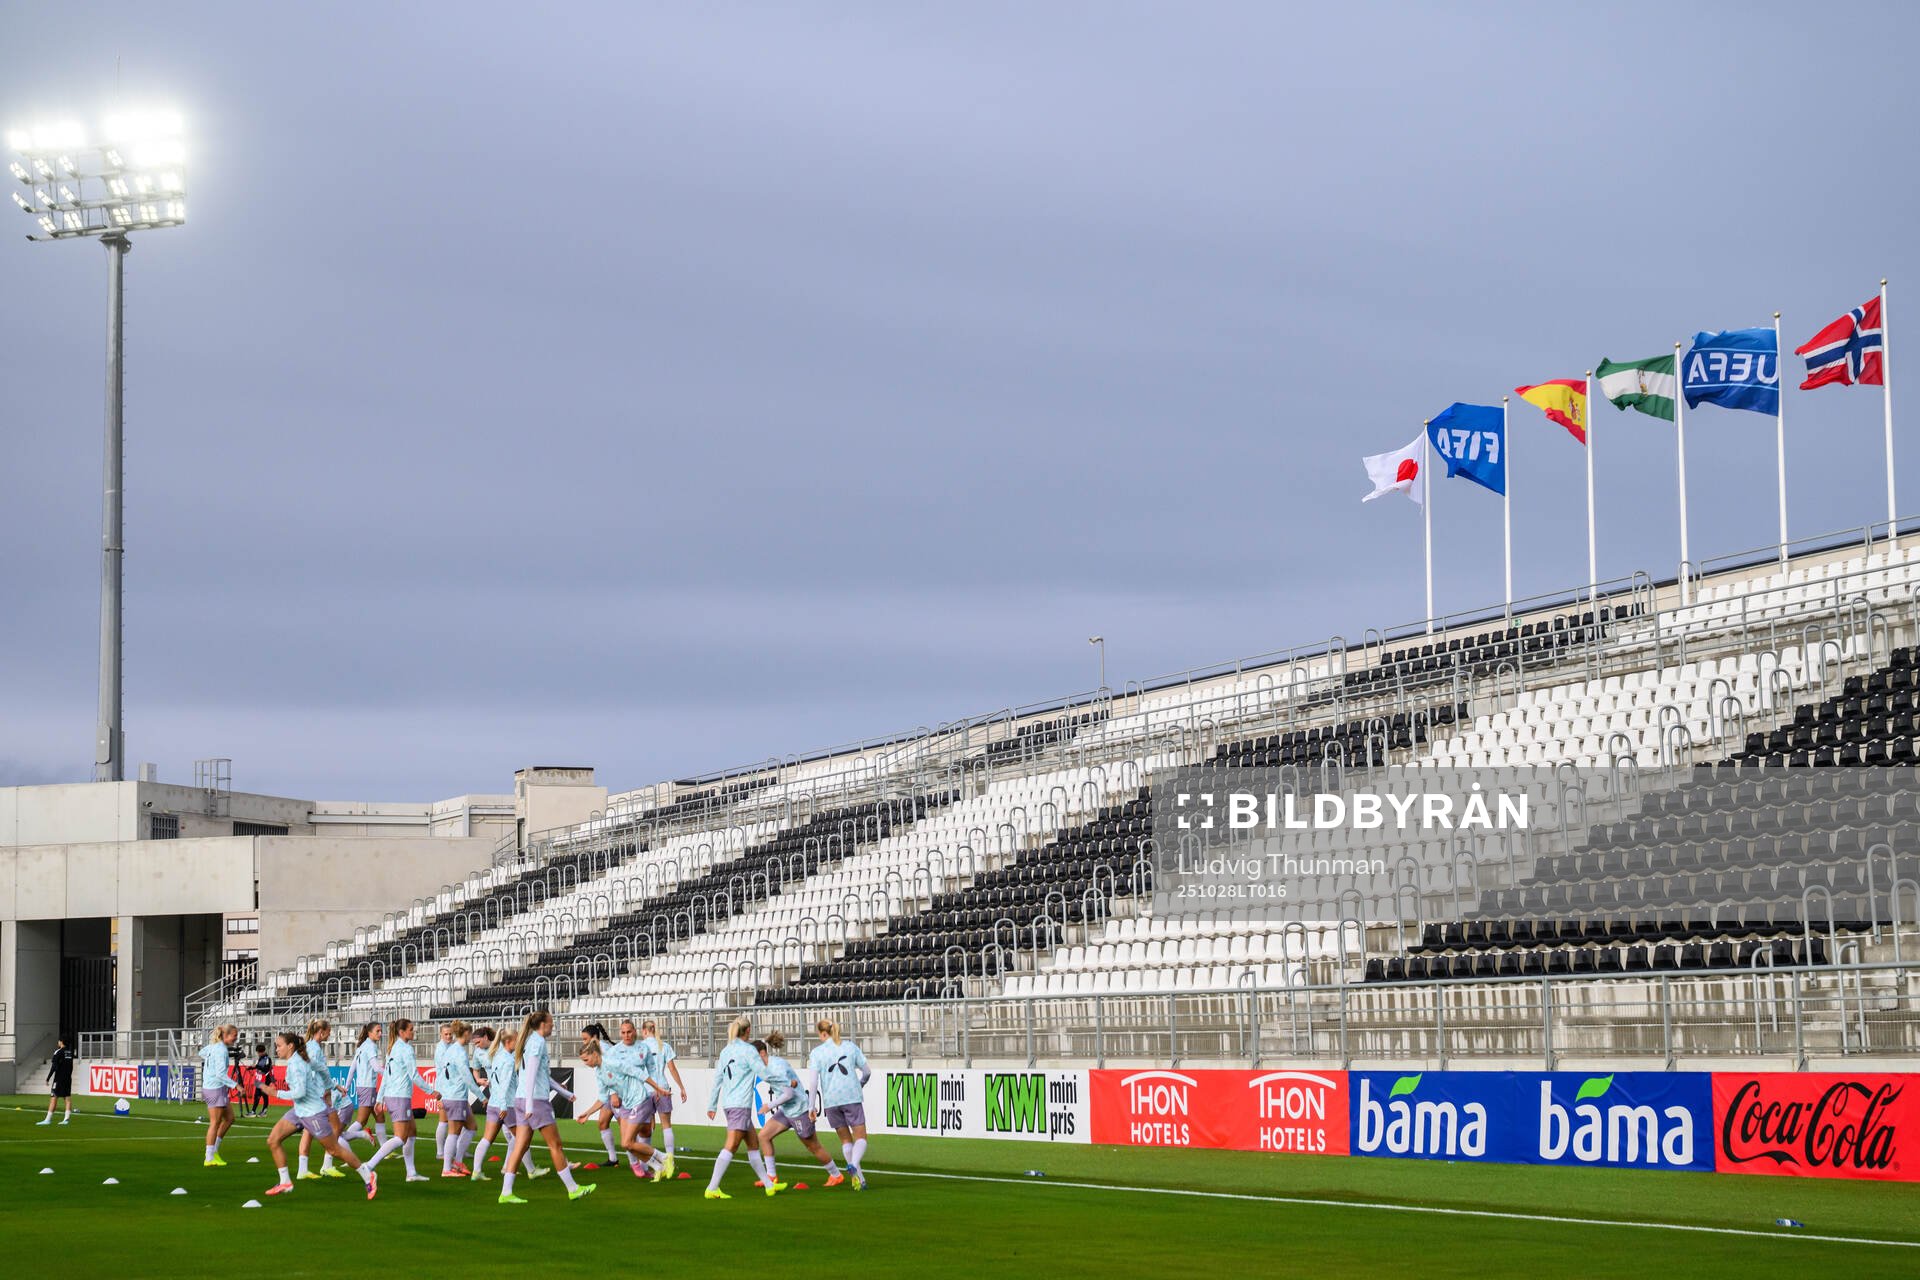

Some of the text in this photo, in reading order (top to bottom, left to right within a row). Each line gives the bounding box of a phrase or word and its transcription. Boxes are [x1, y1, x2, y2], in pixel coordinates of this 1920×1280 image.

[91, 1068, 113, 1091] VG
[114, 1069, 138, 1093] VG
[940, 1073, 965, 1103] mini
[1049, 1074, 1078, 1105] mini
[1120, 1070, 1198, 1117] THON
[1249, 1071, 1337, 1121] THON
[886, 1072, 939, 1130] KIWI
[984, 1072, 1047, 1134] KIWI
[1357, 1077, 1488, 1158] bama
[940, 1103, 963, 1136] pris
[1049, 1105, 1076, 1141] pris
[1130, 1122, 1191, 1146] HOTELS
[1539, 1079, 1695, 1166] bama
[1259, 1126, 1327, 1153] HOTELS
